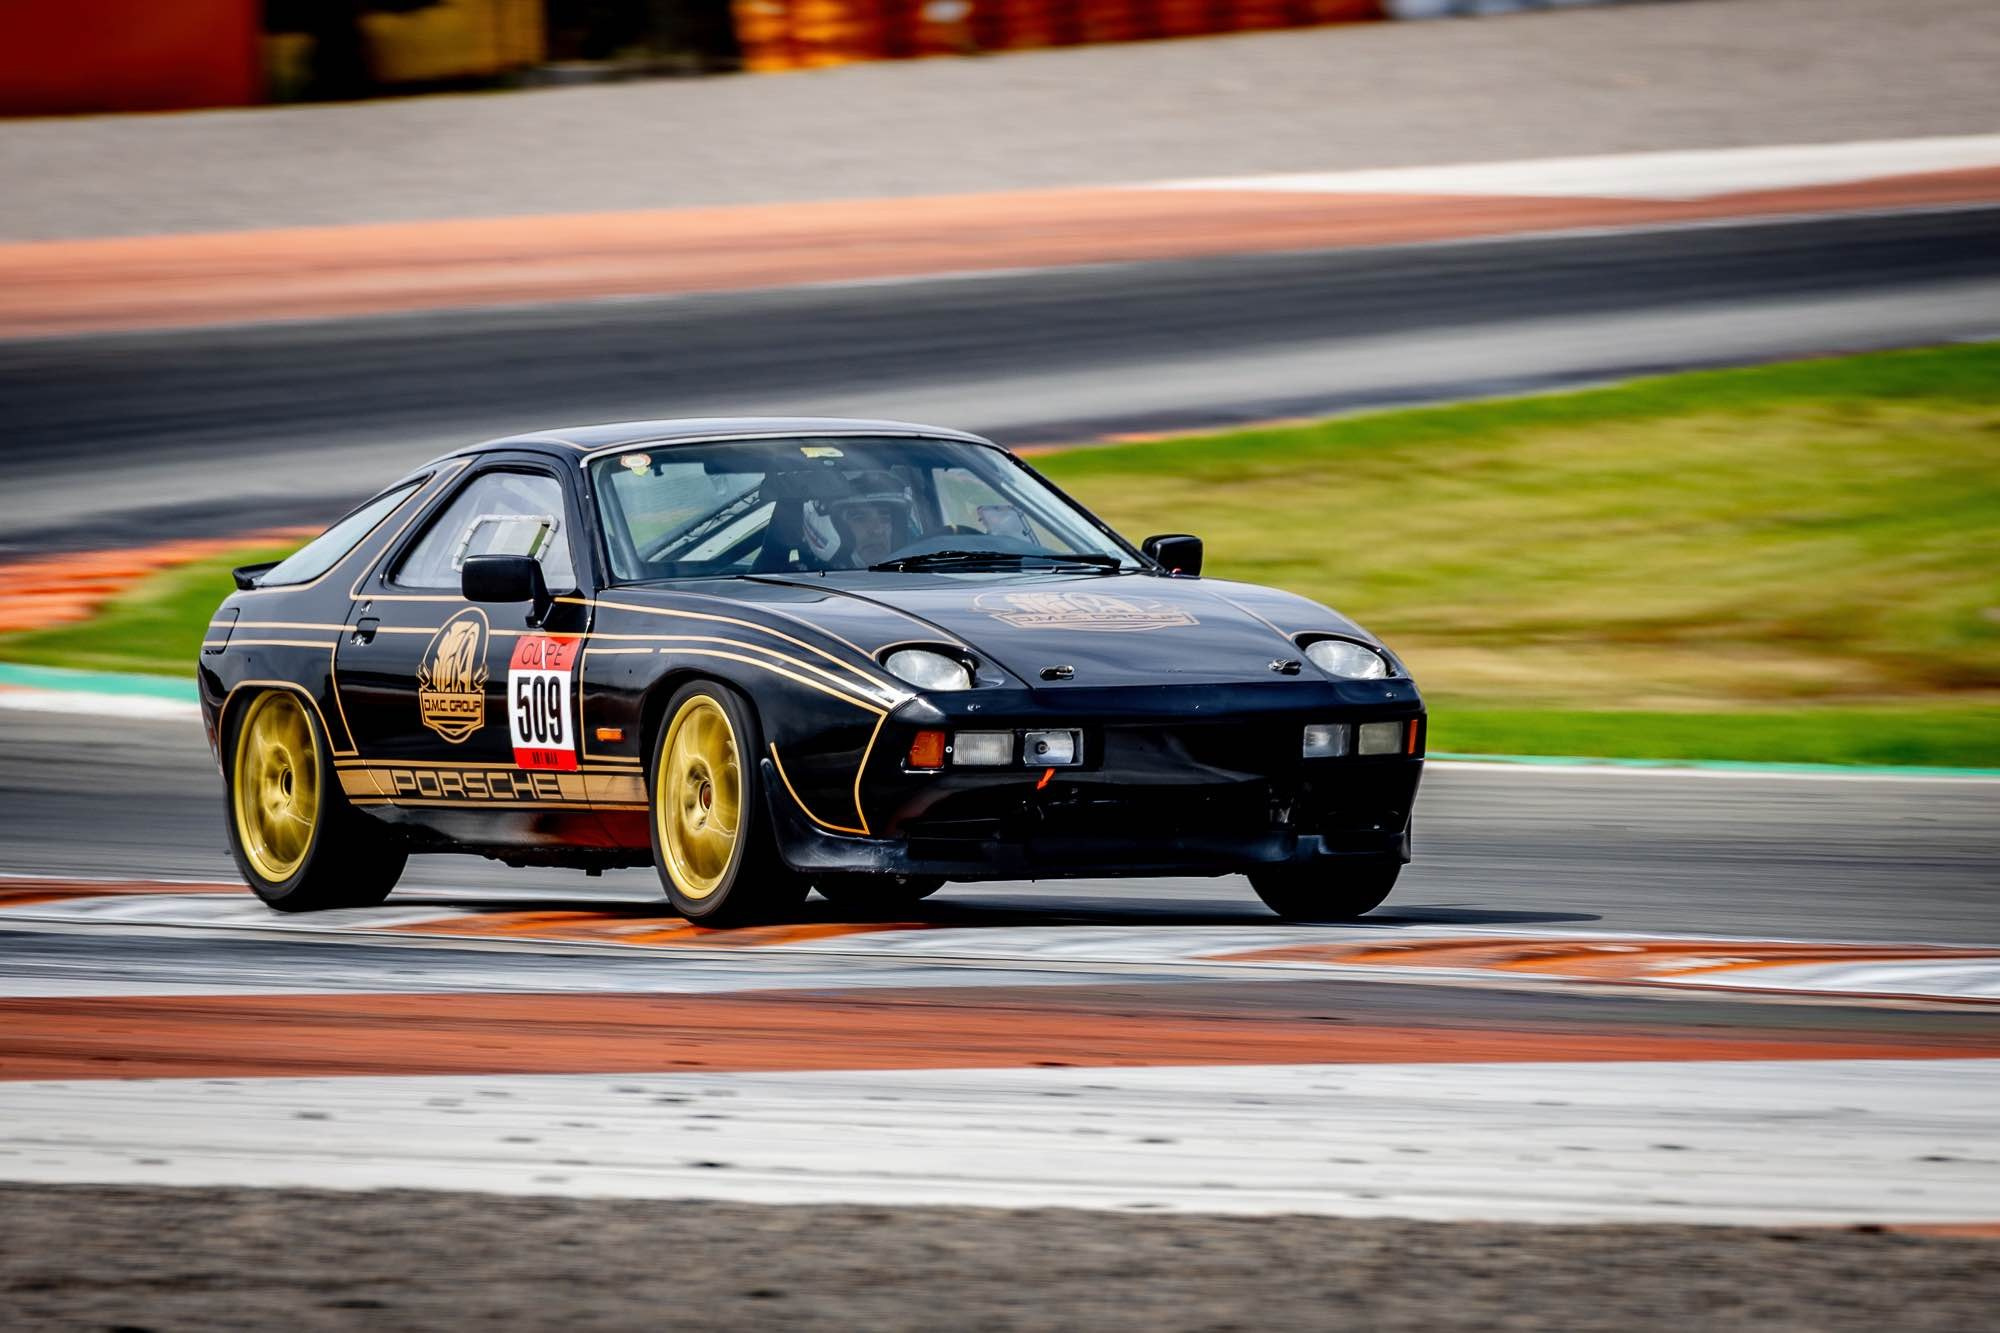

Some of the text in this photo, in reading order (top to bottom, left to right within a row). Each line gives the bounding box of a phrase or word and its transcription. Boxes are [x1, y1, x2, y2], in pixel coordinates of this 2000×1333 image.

[449, 699, 481, 713] GROUP
[517, 675, 563, 744] 509
[391, 769, 564, 800] PORSCHE
